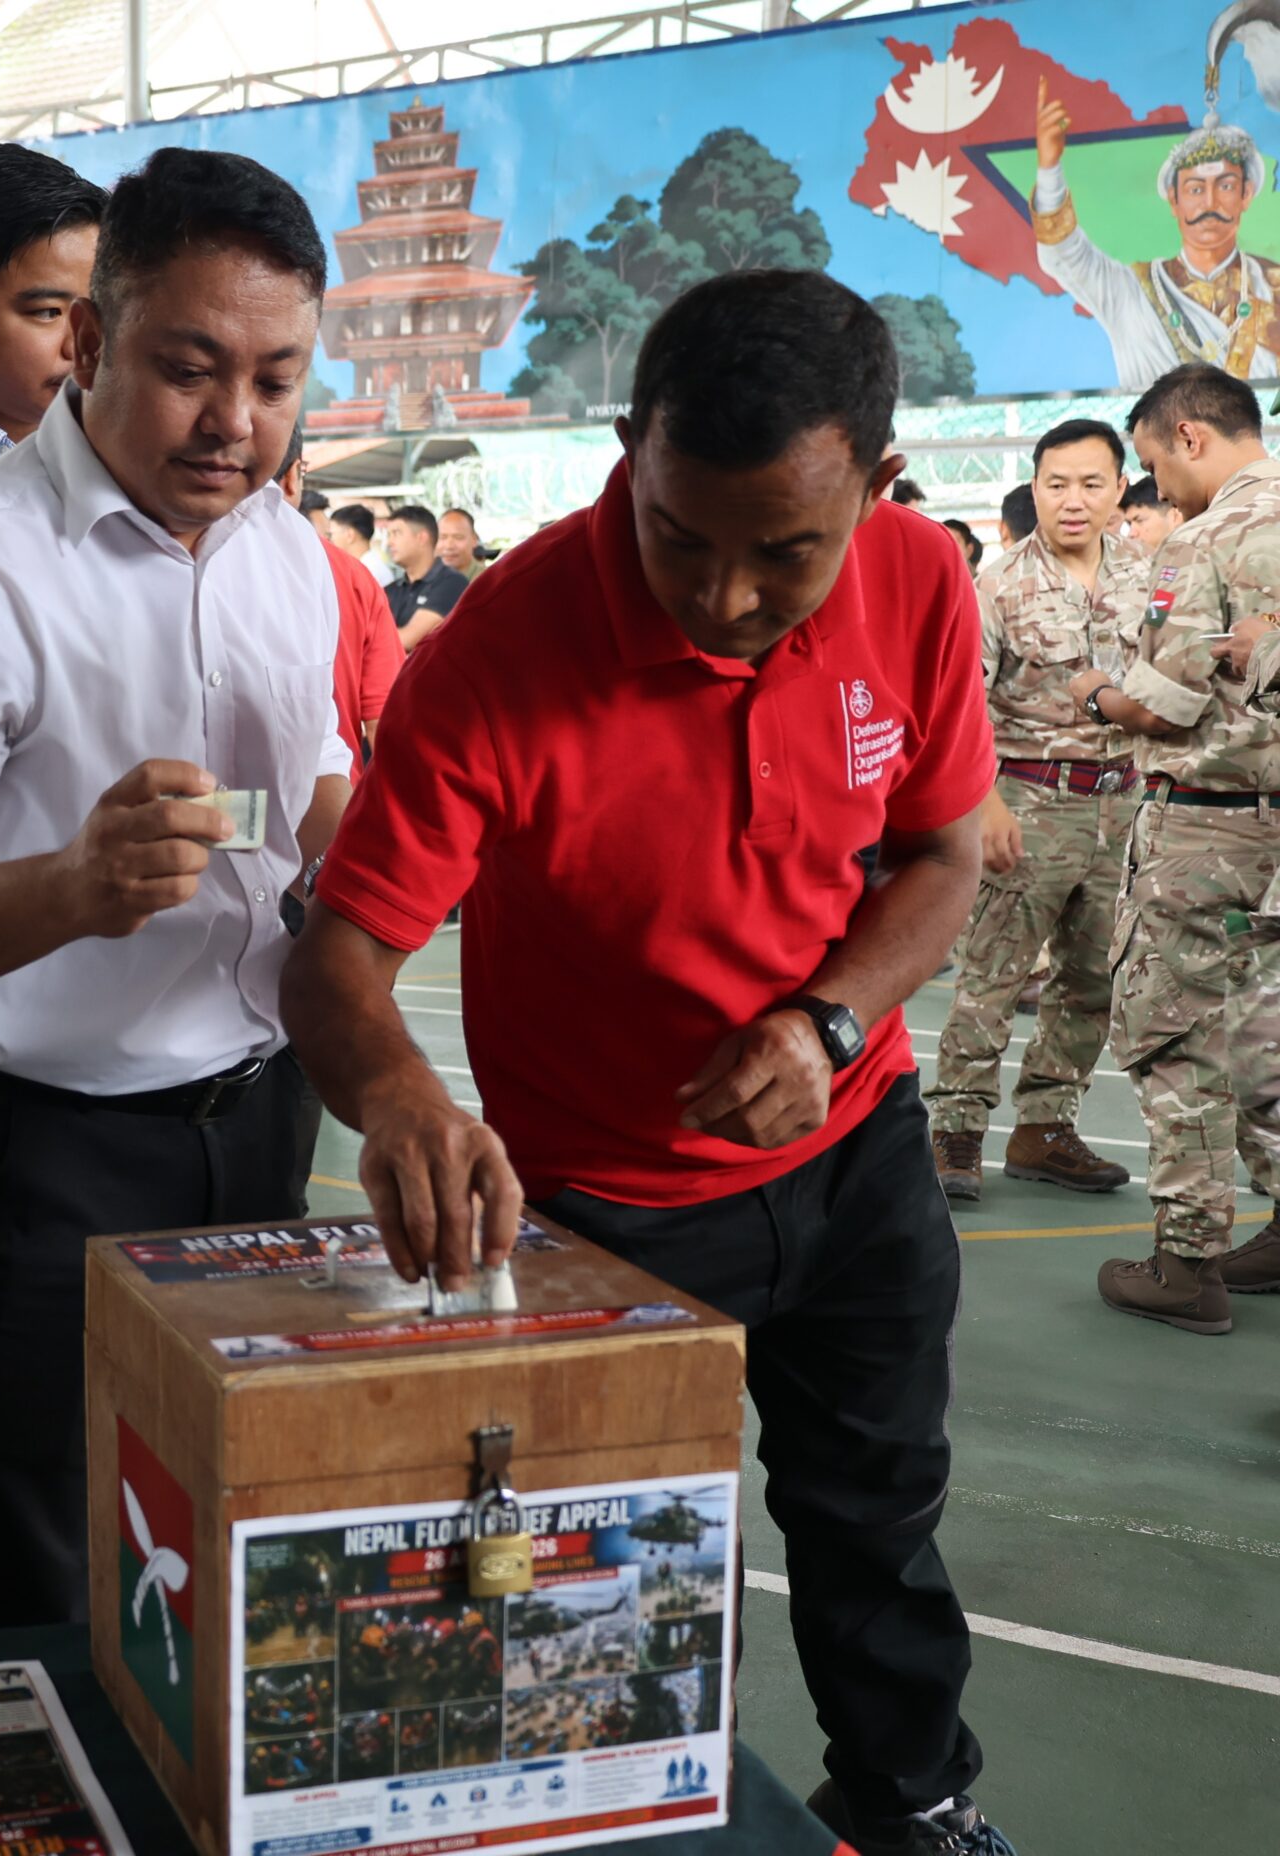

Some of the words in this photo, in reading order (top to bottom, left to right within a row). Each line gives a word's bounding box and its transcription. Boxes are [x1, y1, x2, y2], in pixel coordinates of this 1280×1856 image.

[585, 402, 632, 418] NYATAP
[853, 718, 894, 739] Defence
[855, 764, 883, 787] Nepal
[180, 1229, 306, 1252] NEPAL
[309, 1223, 382, 1241] FLO
[180, 1243, 304, 1265] RELIEF
[237, 1260, 267, 1271] 26
[344, 1525, 407, 1556] NEPAL
[557, 1498, 633, 1532] APPEAL
[424, 1550, 446, 1571] 26
